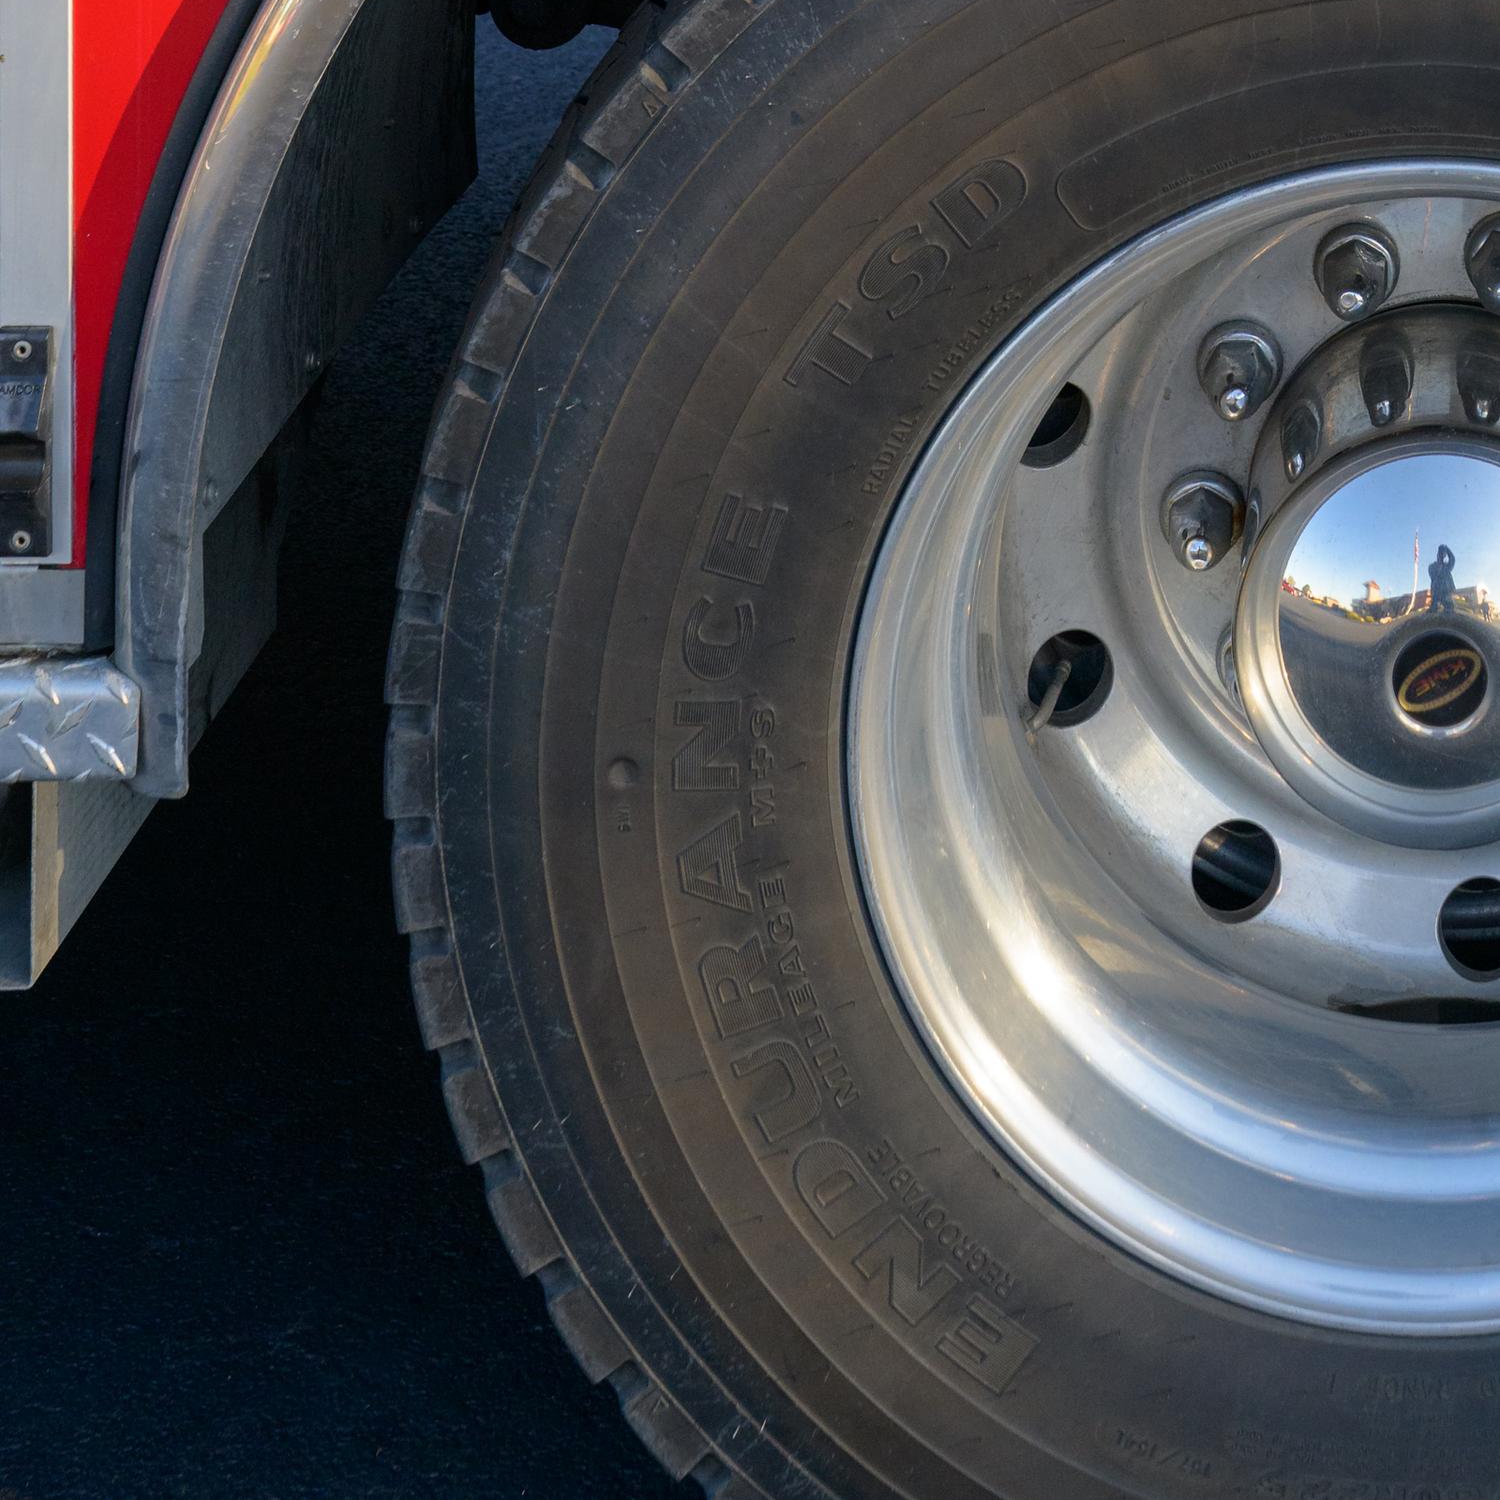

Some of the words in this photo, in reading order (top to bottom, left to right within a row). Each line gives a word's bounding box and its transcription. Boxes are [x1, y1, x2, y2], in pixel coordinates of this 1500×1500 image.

[785, 156, 1030, 388] TSD
[858, 409, 919, 499] RADIAL
[920, 283, 1024, 397] TUBELESS
[748, 707, 777, 826] M+S
[673, 493, 1041, 1395] ENDURANCE
[758, 874, 863, 1109] MILEAGE
[863, 1139, 1017, 1298] REGROOVABLE
